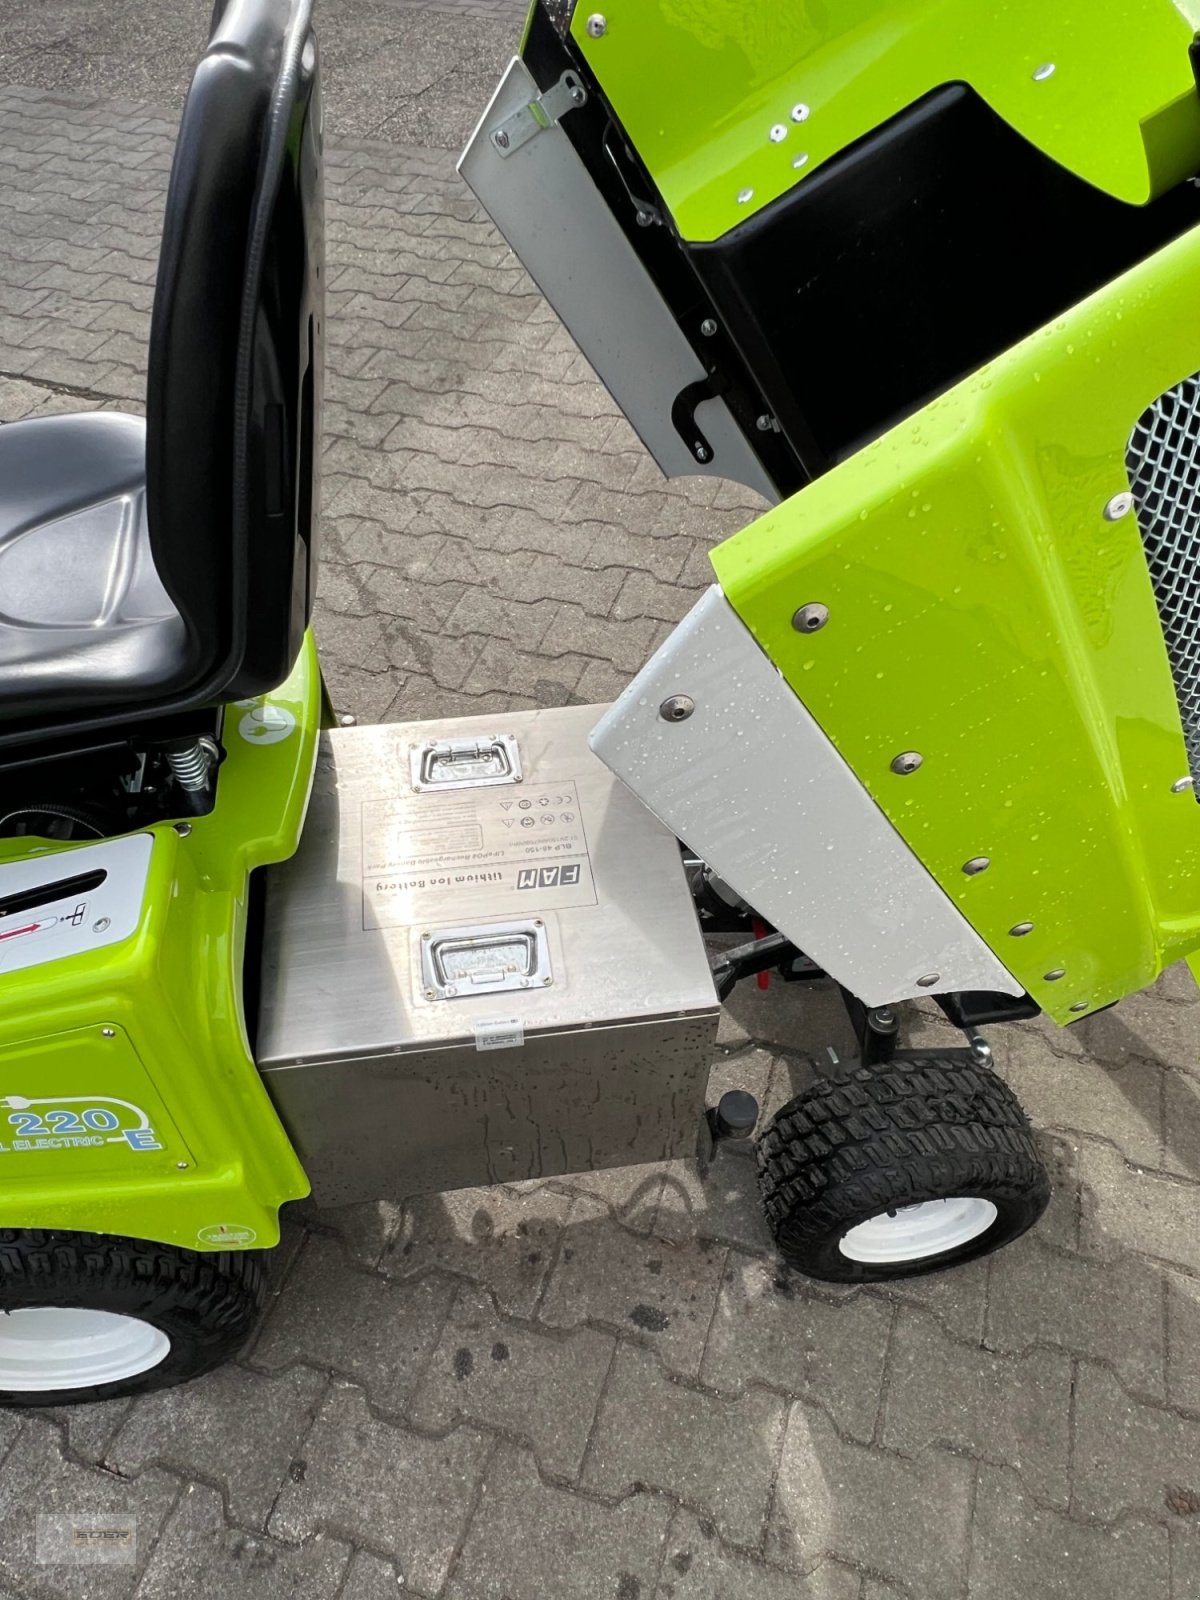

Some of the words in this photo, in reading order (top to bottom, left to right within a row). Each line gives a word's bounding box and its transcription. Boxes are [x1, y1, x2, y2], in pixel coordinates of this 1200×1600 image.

[376, 880, 426, 892] Battery
[430, 877, 451, 886] Ion
[517, 864, 581, 890] FAM
[8, 1109, 119, 1135] 220
[13, 1136, 104, 1150] ELECTRIC
[122, 1128, 163, 1151] E
